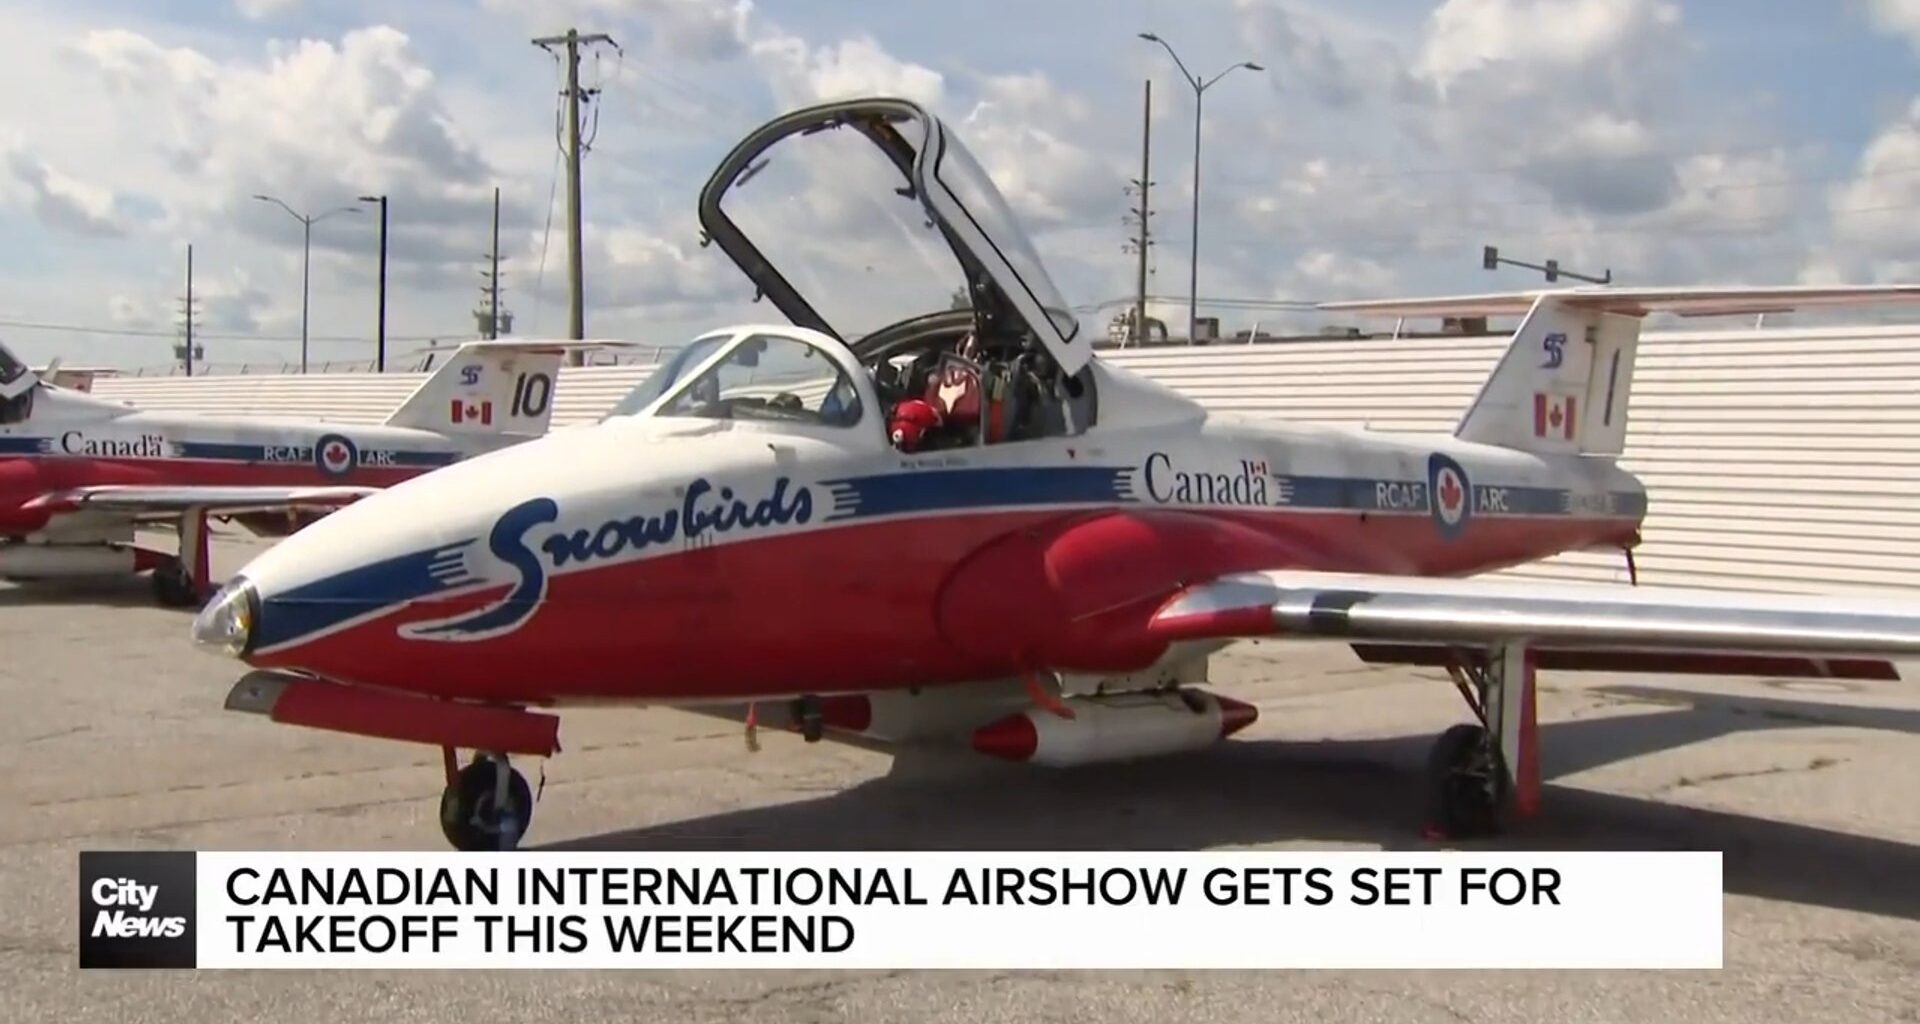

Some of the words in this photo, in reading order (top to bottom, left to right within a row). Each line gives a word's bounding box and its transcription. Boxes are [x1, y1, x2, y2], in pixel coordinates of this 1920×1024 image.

[511, 372, 550, 417] 10
[61, 431, 162, 457] Canada
[263, 447, 306, 461] RCAF
[366, 451, 397, 465] ARC
[1144, 451, 1267, 505] Canada
[1376, 483, 1421, 508] RCAF
[1480, 488, 1509, 511] ARC
[402, 476, 813, 641] Snowbirds
